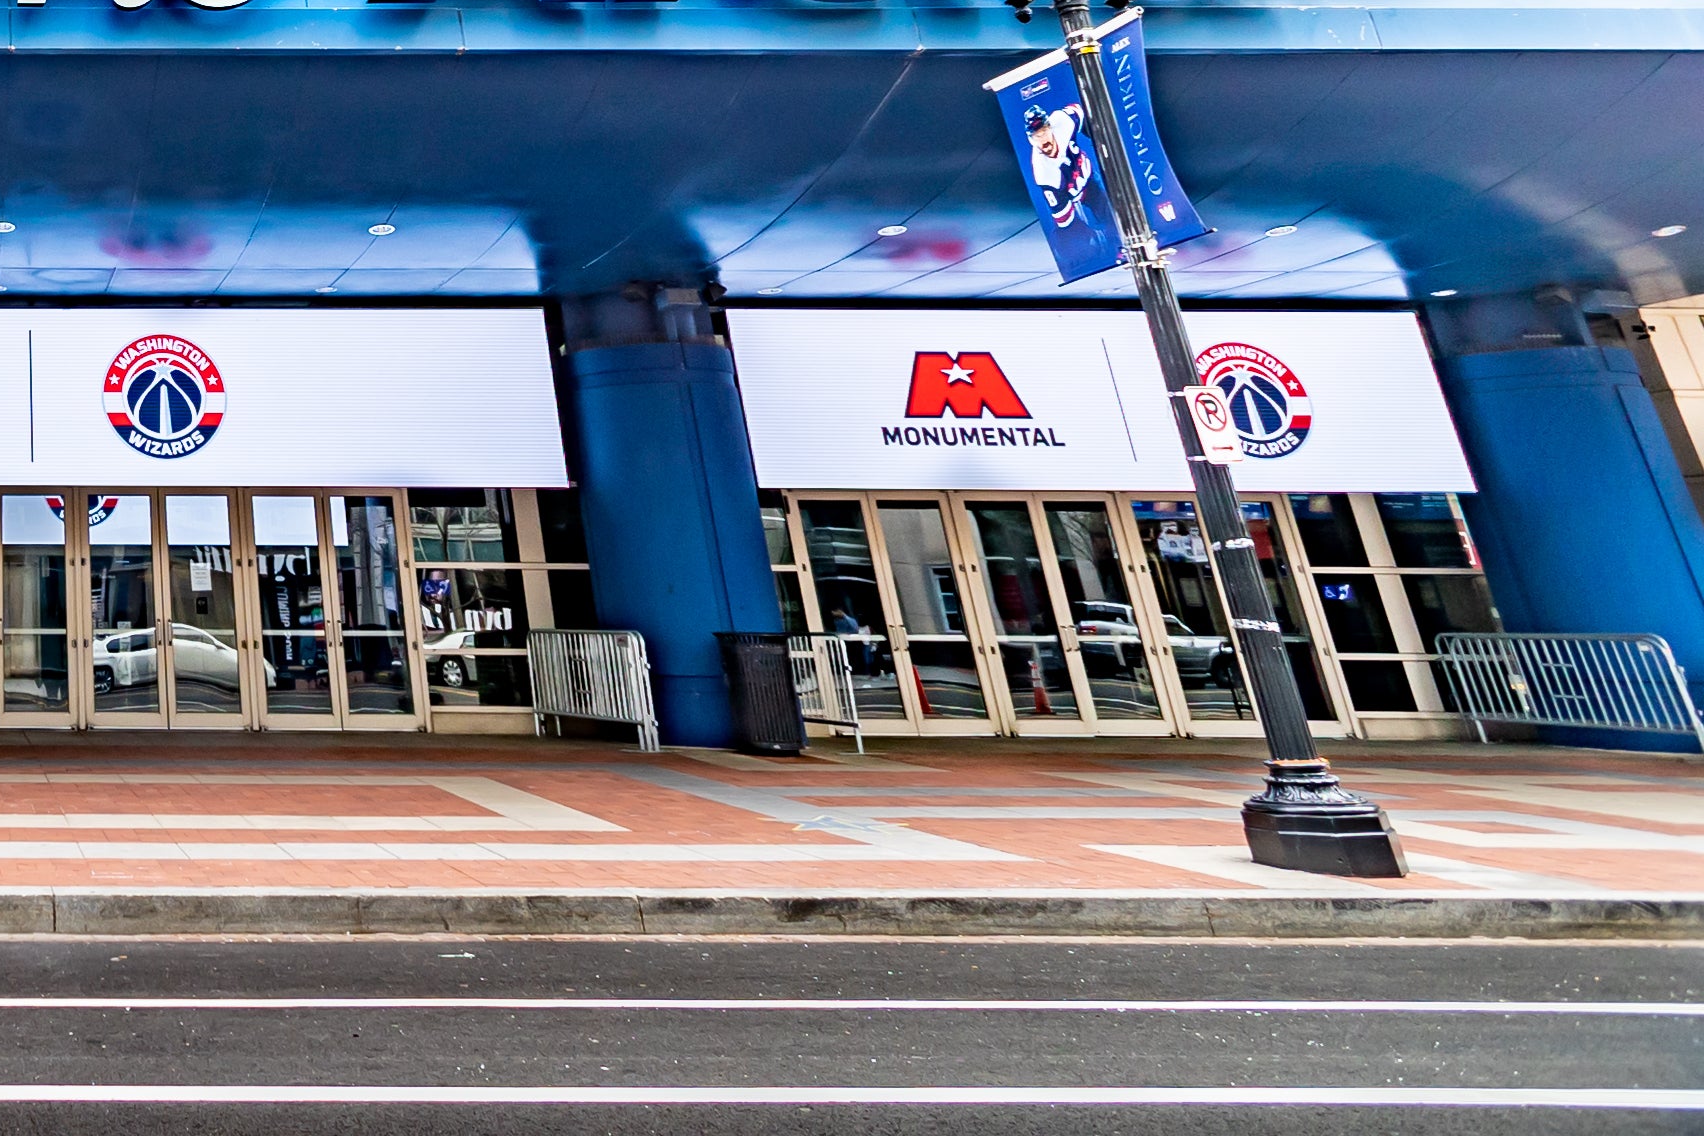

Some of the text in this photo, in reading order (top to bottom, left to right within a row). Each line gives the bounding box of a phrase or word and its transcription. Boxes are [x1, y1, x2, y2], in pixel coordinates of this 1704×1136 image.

[114, 337, 210, 371] WASHINGTON
[1196, 345, 1287, 378] WASHINGTON
[128, 430, 205, 456] WIZARDS
[881, 426, 1066, 447] MONUMENTAL
[1241, 431, 1301, 456] IZARDS
